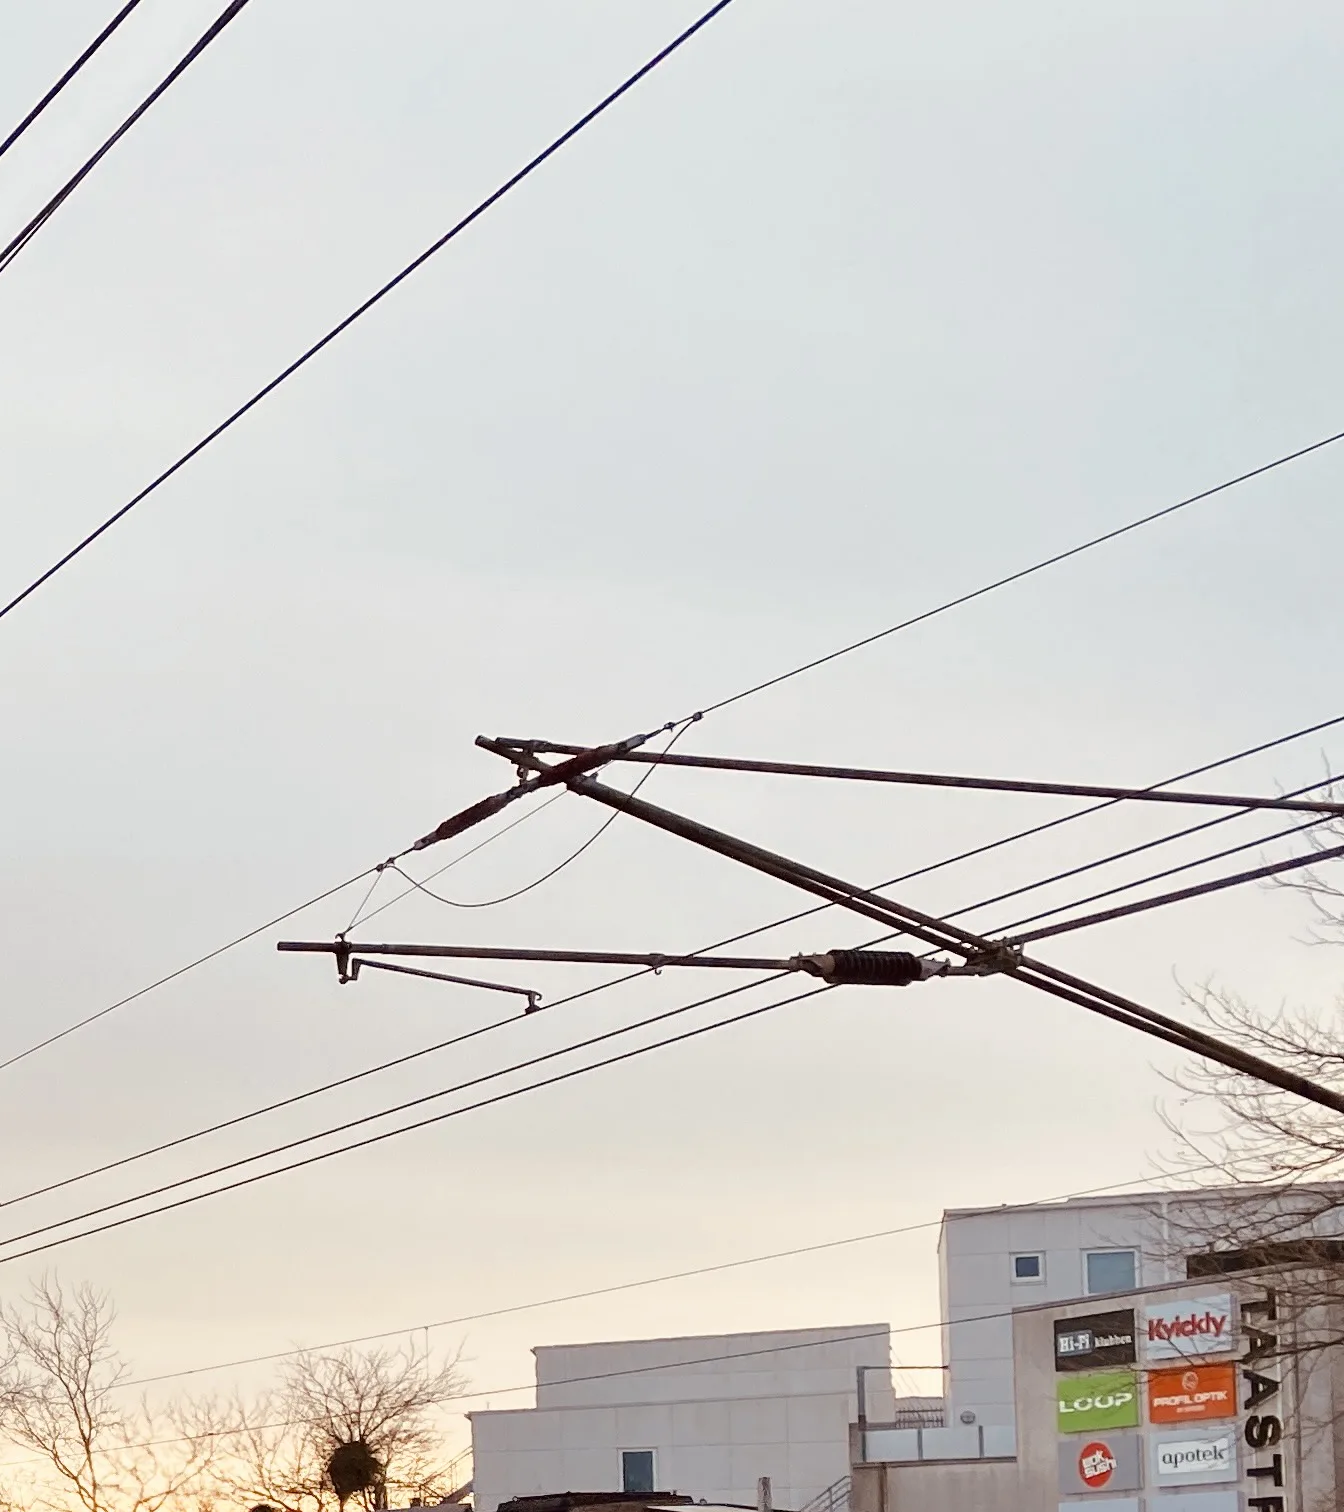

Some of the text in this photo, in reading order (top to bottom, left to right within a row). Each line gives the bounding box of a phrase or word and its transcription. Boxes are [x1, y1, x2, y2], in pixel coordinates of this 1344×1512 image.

[1148, 1311, 1228, 1342] Kvickly
[1059, 1333, 1090, 1353] Hi-Fi
[1162, 1444, 1225, 1469] apotek
